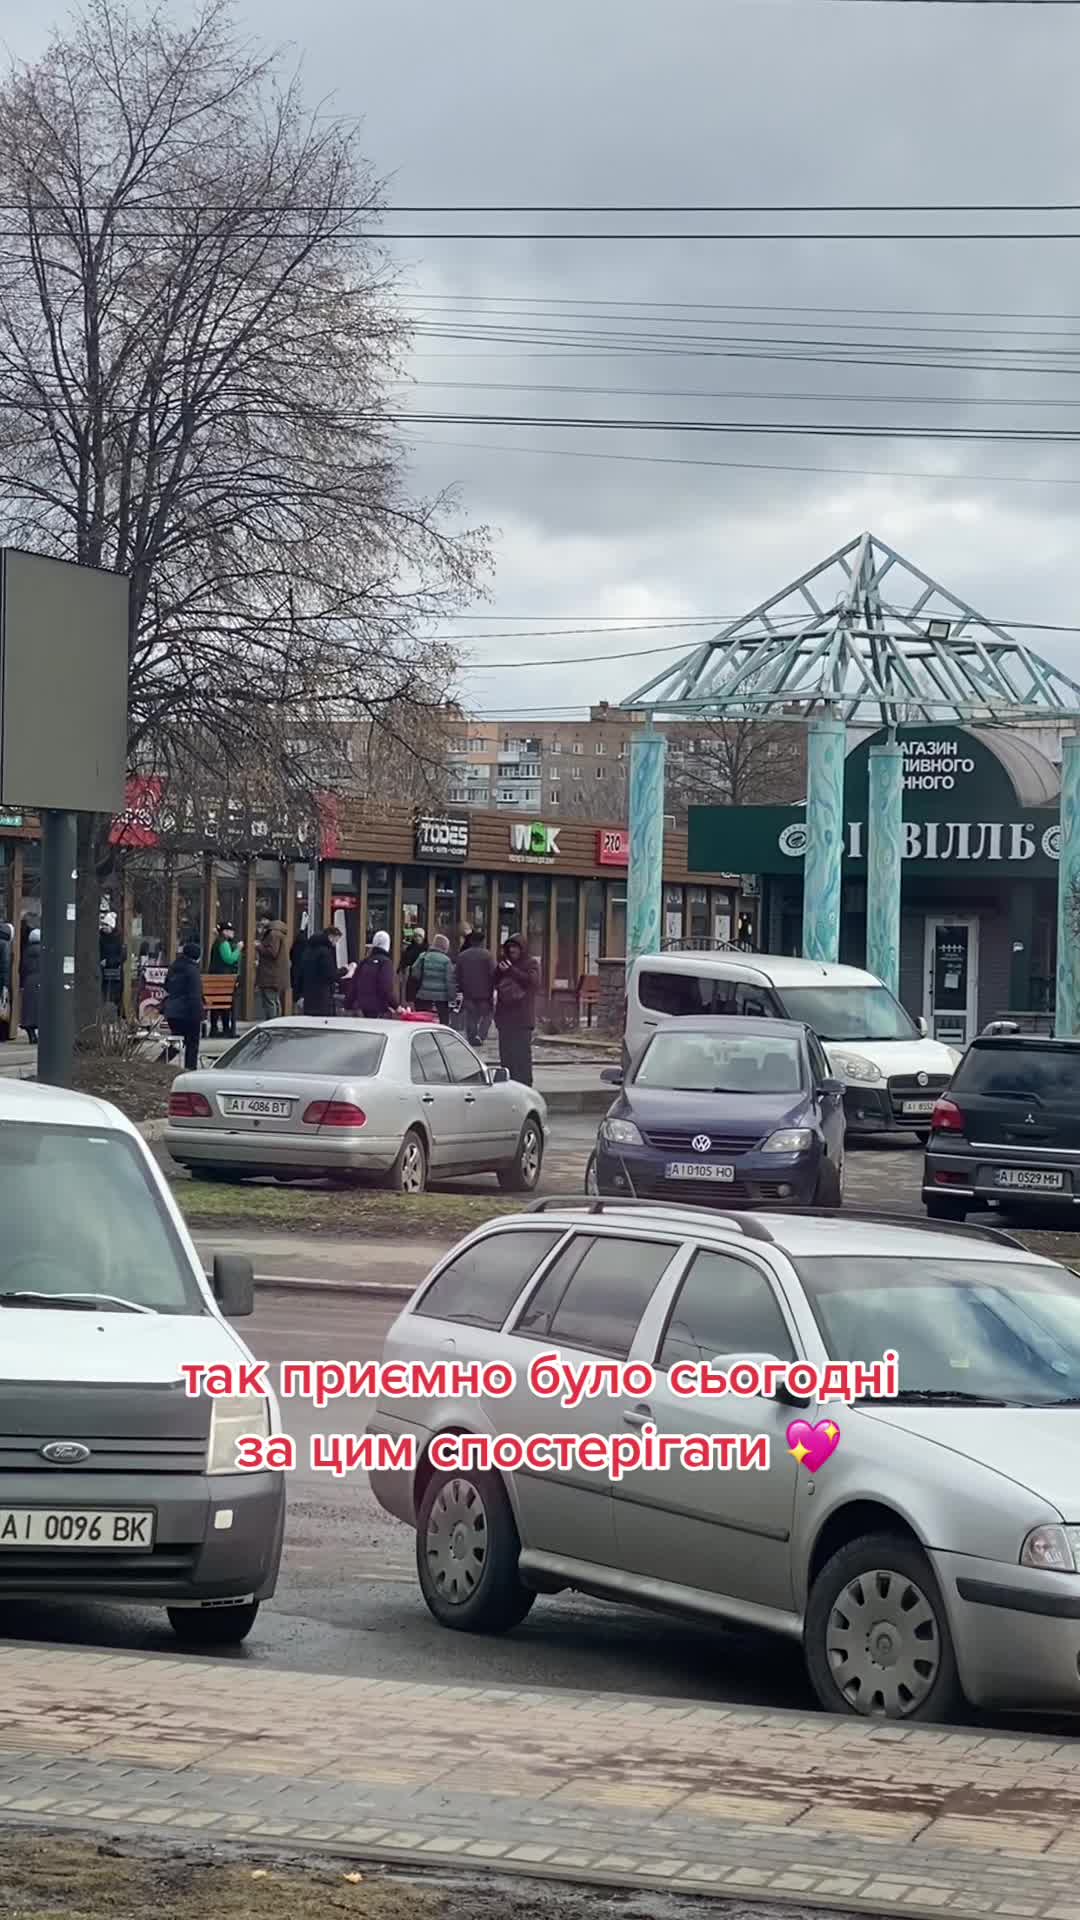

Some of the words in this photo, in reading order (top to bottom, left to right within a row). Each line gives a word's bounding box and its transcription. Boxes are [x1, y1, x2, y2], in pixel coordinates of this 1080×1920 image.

[886, 741, 957, 755] АГАЗИН
[420, 822, 468, 846] TODES
[247, 1100, 270, 1112] 4086
[272, 1101, 287, 1113] BT
[687, 1164, 713, 1177] 0105
[1017, 1171, 1042, 1184] 0529
[1043, 1174, 1060, 1185] MH
[1, 1513, 32, 1540] AI
[44, 1514, 103, 1541] 0096
[112, 1516, 148, 1542] BK
